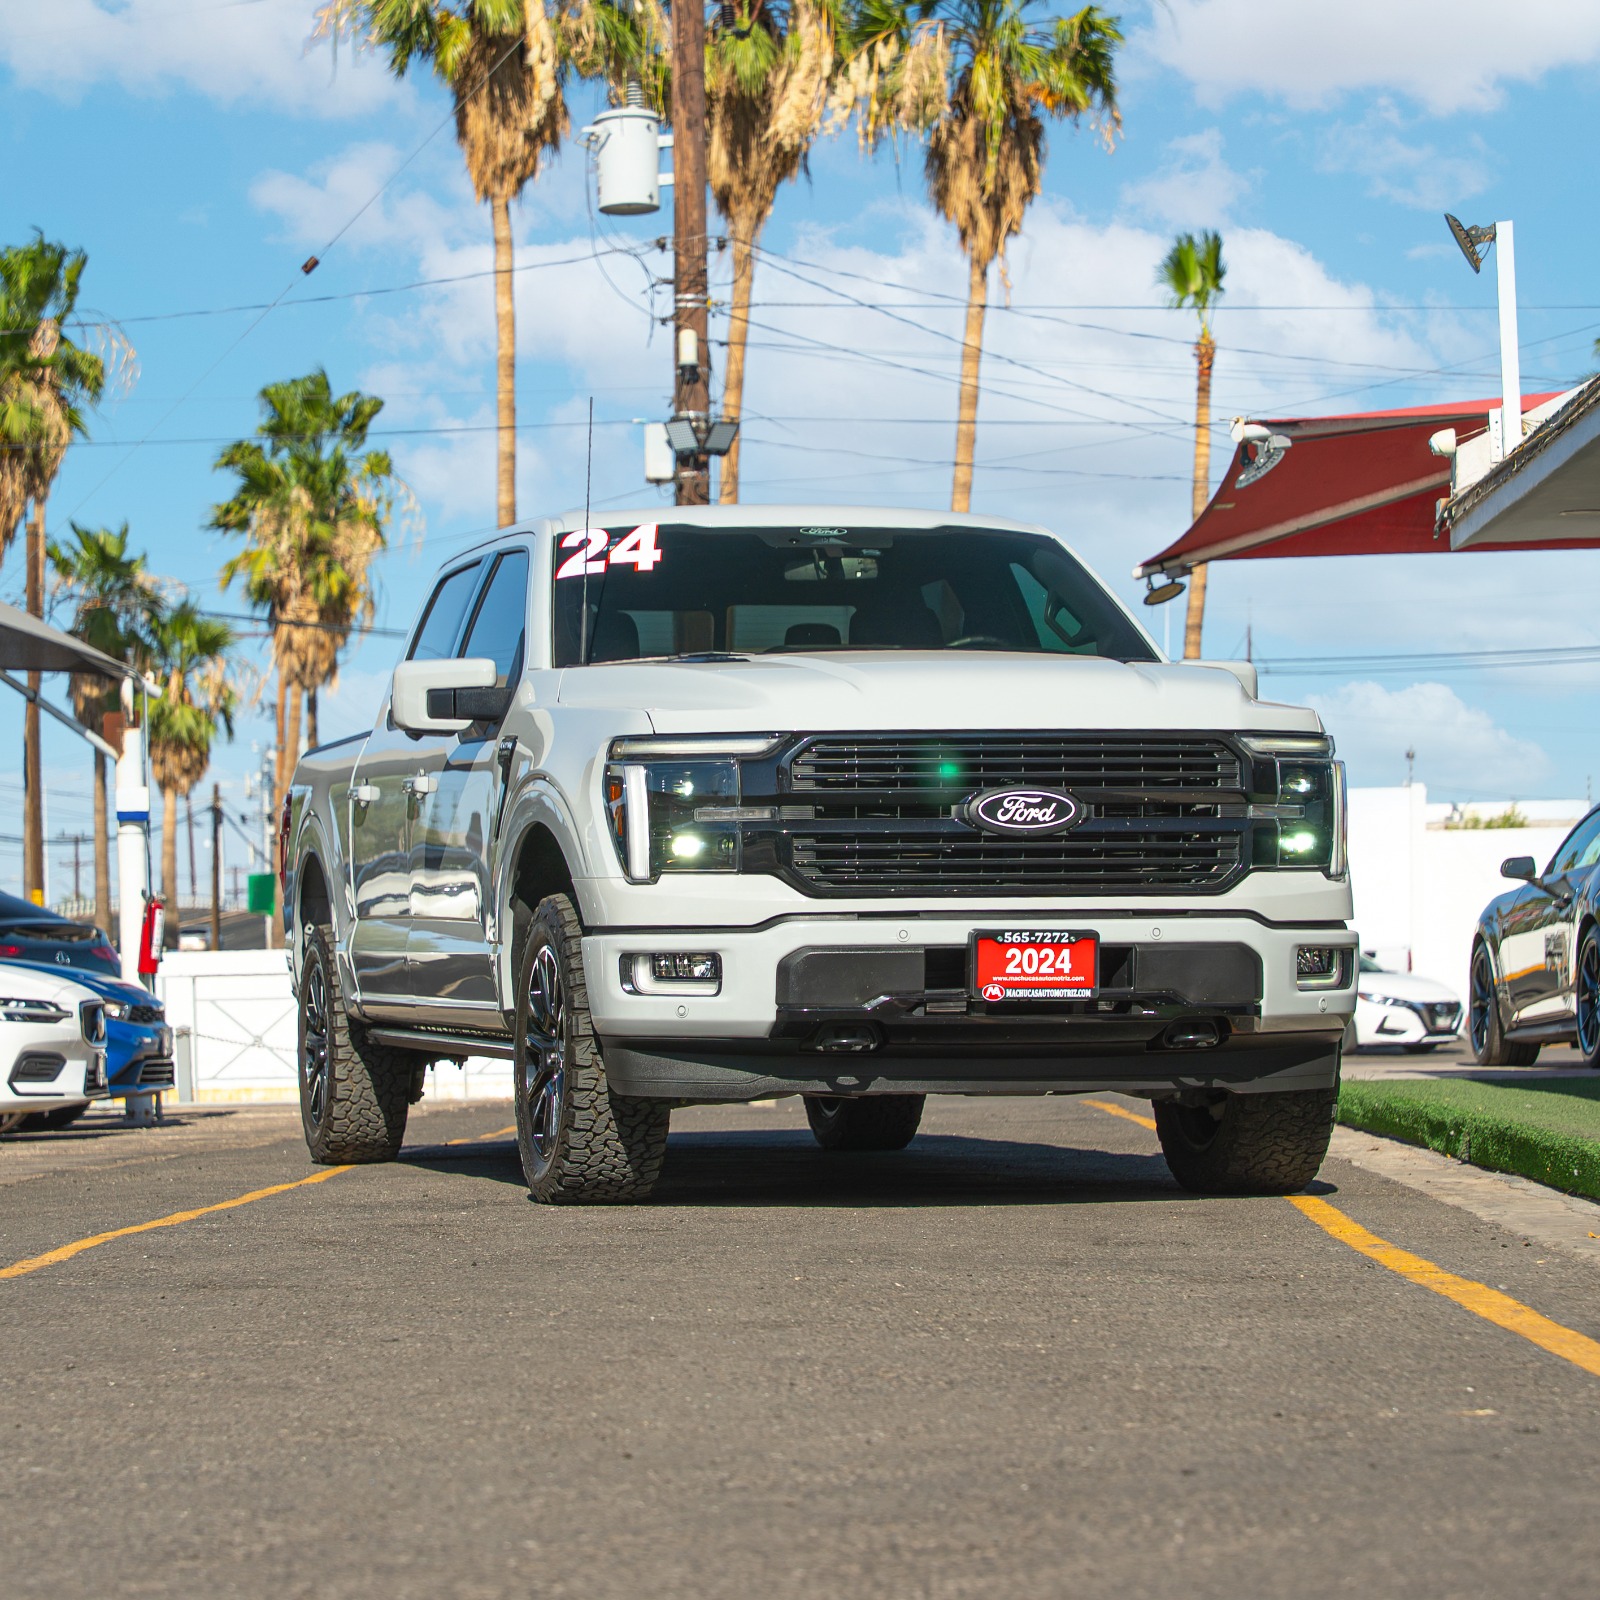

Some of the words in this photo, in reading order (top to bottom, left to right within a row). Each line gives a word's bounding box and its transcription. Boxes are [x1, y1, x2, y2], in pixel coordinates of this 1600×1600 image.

[809, 527, 838, 535] Ford
[554, 522, 662, 580] 24
[997, 796, 1058, 822] Ford
[1003, 931, 1069, 943] 565-7272
[1005, 947, 1072, 974] 2024
[1006, 988, 1091, 998] MACHUCASAUTOMOTRIZ.COM
